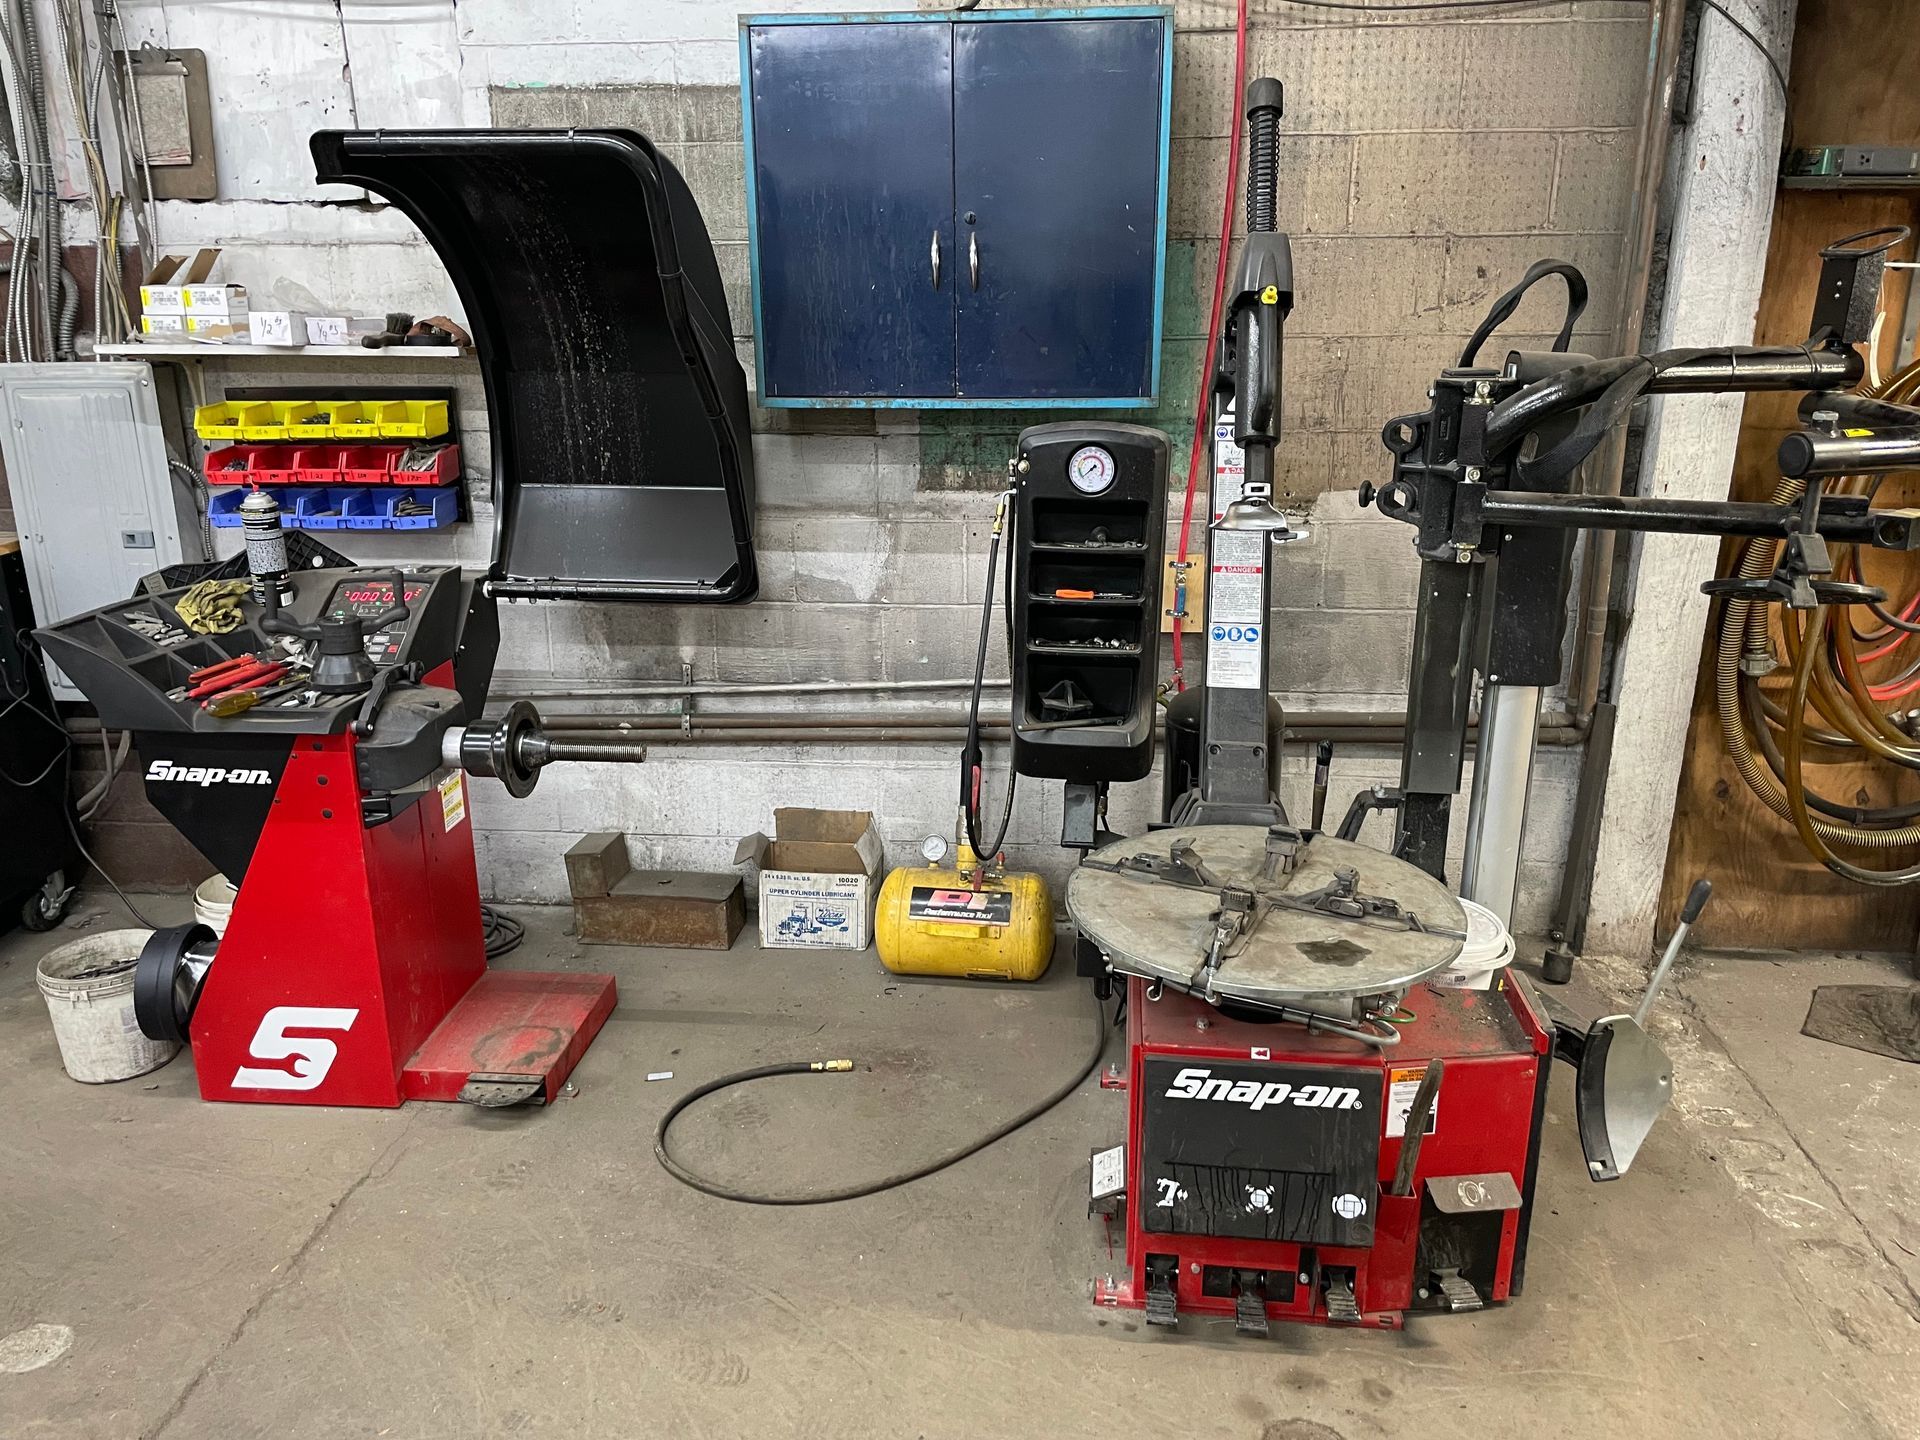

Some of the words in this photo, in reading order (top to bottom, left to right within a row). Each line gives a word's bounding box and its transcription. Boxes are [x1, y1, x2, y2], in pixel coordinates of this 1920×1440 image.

[145, 760, 270, 787] Snap-on
[769, 888, 790, 896] UPPER
[790, 889, 821, 897] CYLINDER
[821, 890, 856, 899] LUBRICANT
[923, 908, 976, 919] Performance
[976, 911, 993, 920] Tool
[1164, 1068, 1361, 1111] Snap-on
